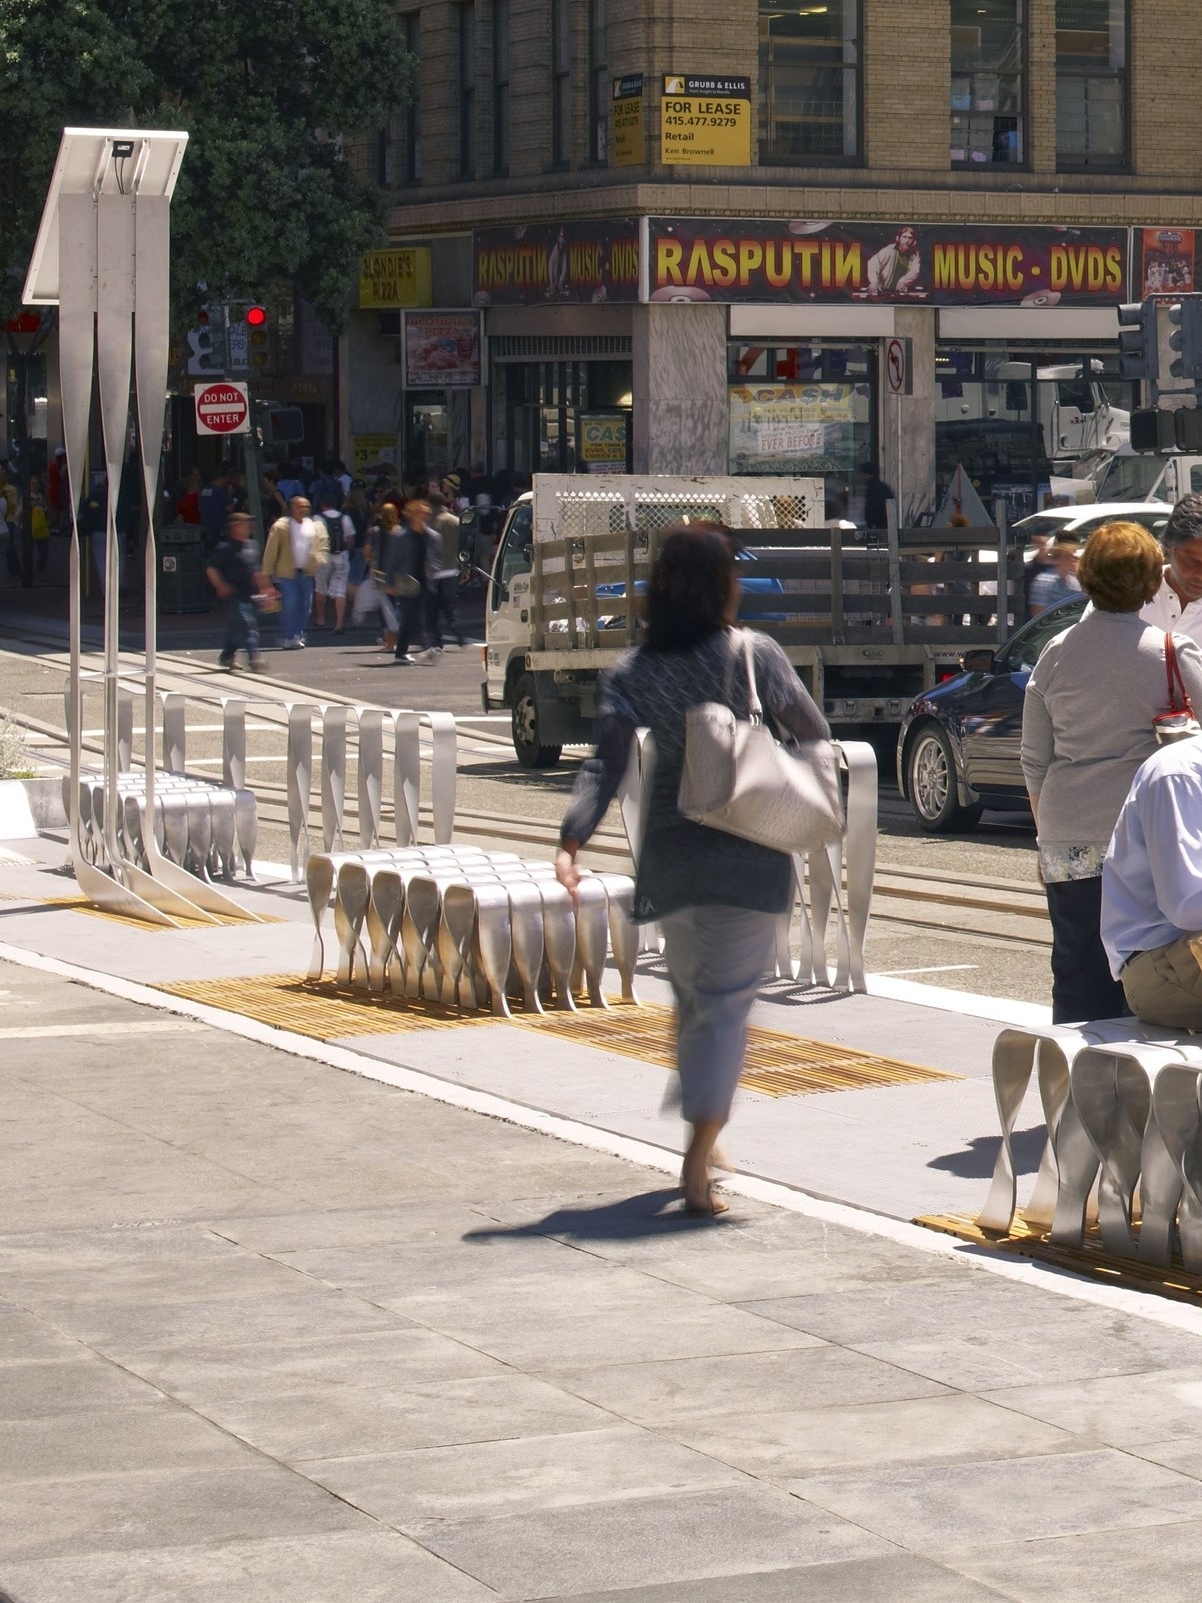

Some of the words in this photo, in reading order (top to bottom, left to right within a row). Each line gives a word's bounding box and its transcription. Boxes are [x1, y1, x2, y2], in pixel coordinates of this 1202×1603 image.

[717, 81, 722, 89] &
[665, 102, 692, 113] FOR
[698, 102, 741, 115] LEASE
[665, 116, 736, 127] 415.477.9279
[665, 132, 694, 141] Retail
[682, 148, 714, 156] Brownell
[569, 244, 602, 283] MUSIC
[611, 242, 639, 283] DVDS
[934, 244, 1023, 290] MUSIC
[1051, 246, 1122, 291] DVDS
[204, 393, 217, 402] DO
[219, 392, 238, 402] NOT
[754, 387, 844, 404] CASH
[206, 414, 239, 424] ENTER
[761, 438, 784, 450] EVER
[787, 433, 821, 449] BEFORE
